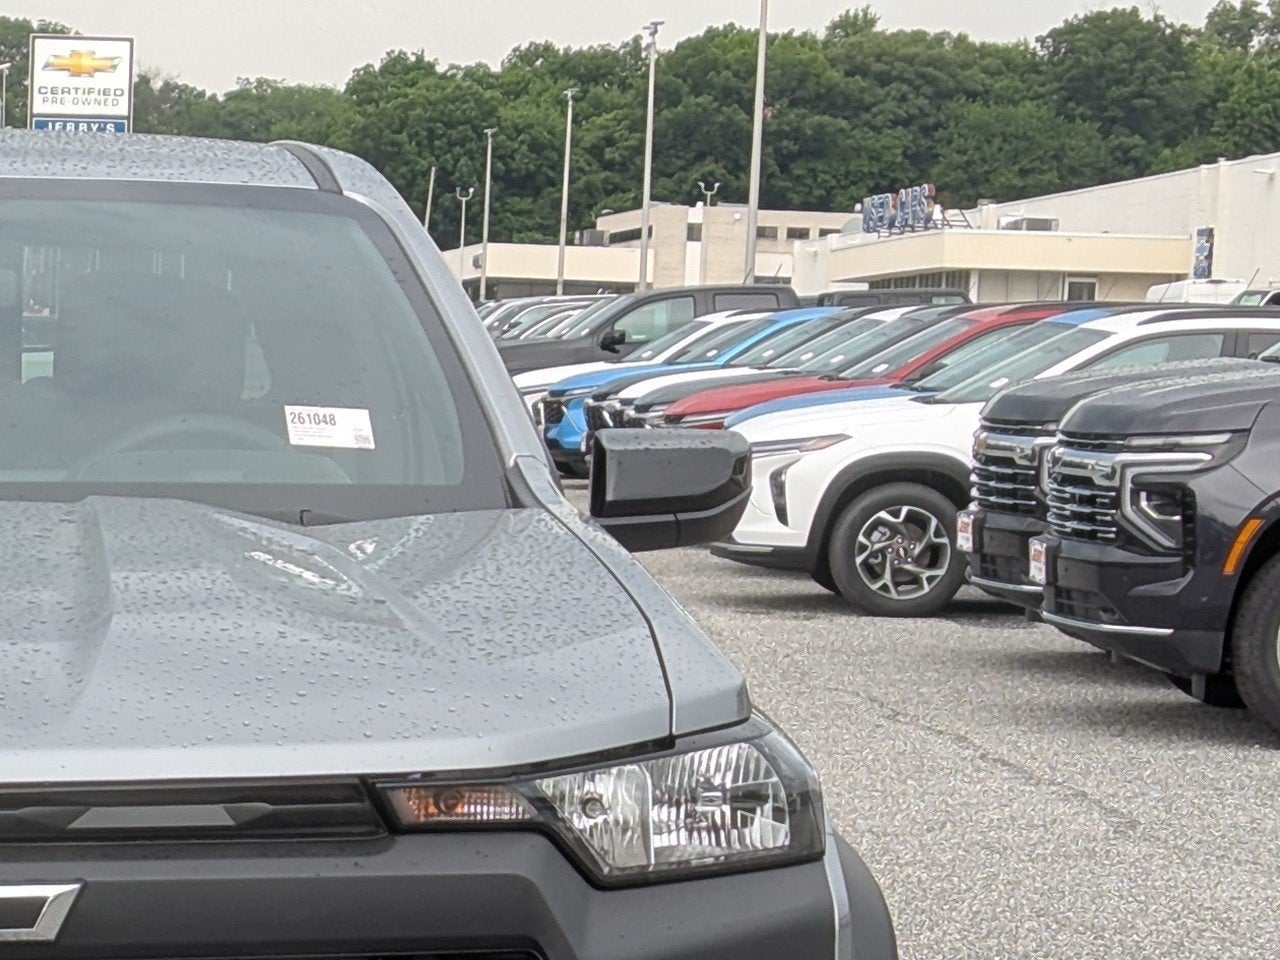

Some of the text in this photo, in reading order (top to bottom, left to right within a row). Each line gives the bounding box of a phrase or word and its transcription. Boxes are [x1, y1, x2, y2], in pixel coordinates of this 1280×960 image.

[38, 86, 124, 97] CERTIFIED
[42, 97, 119, 106] PRE-OWNED
[289, 412, 337, 426] 261048
